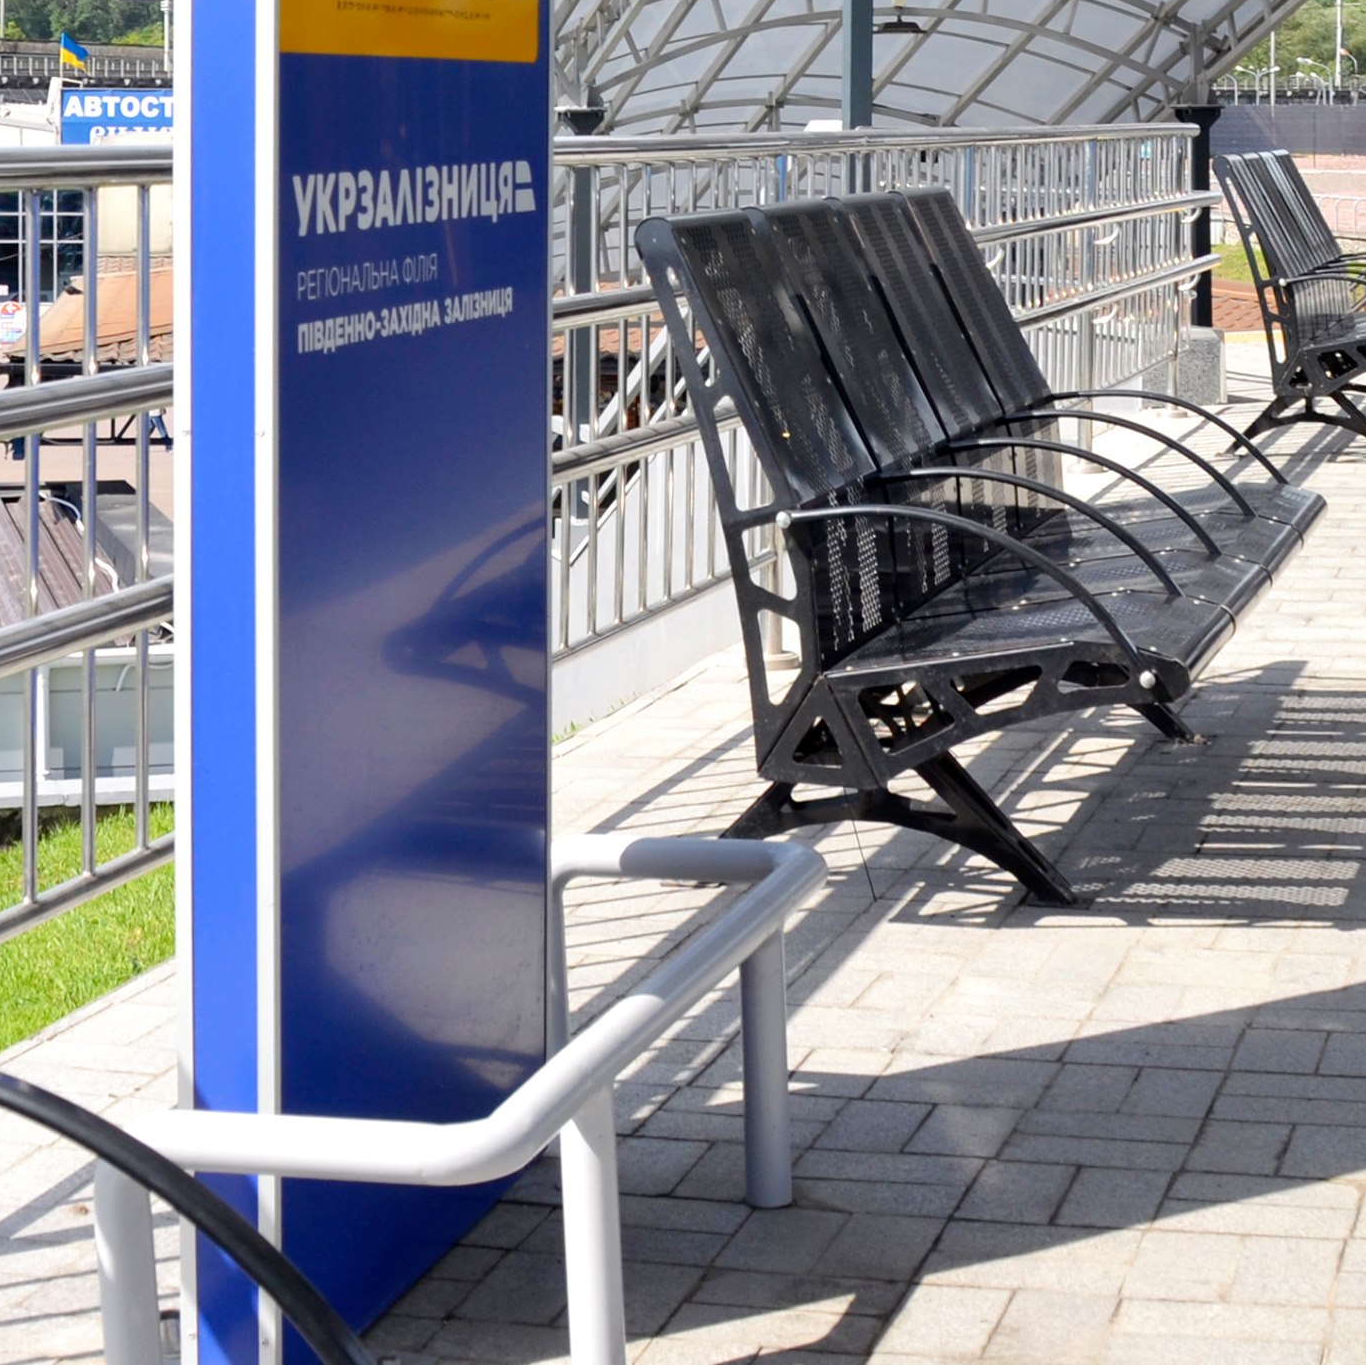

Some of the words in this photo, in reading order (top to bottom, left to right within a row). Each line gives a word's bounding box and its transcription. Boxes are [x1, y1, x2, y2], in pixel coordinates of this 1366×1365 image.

[292, 161, 513, 237] УКРЗАЛІЗНИЦЯ
[297, 259, 400, 301] РЕГІОНАЛЬНА
[402, 253, 438, 283] ФІЛІЯ
[297, 300, 441, 354] ПІВДЕННО-ЗАХІДНА
[444, 287, 513, 325] ЗАЛІЗНИЦЯ
